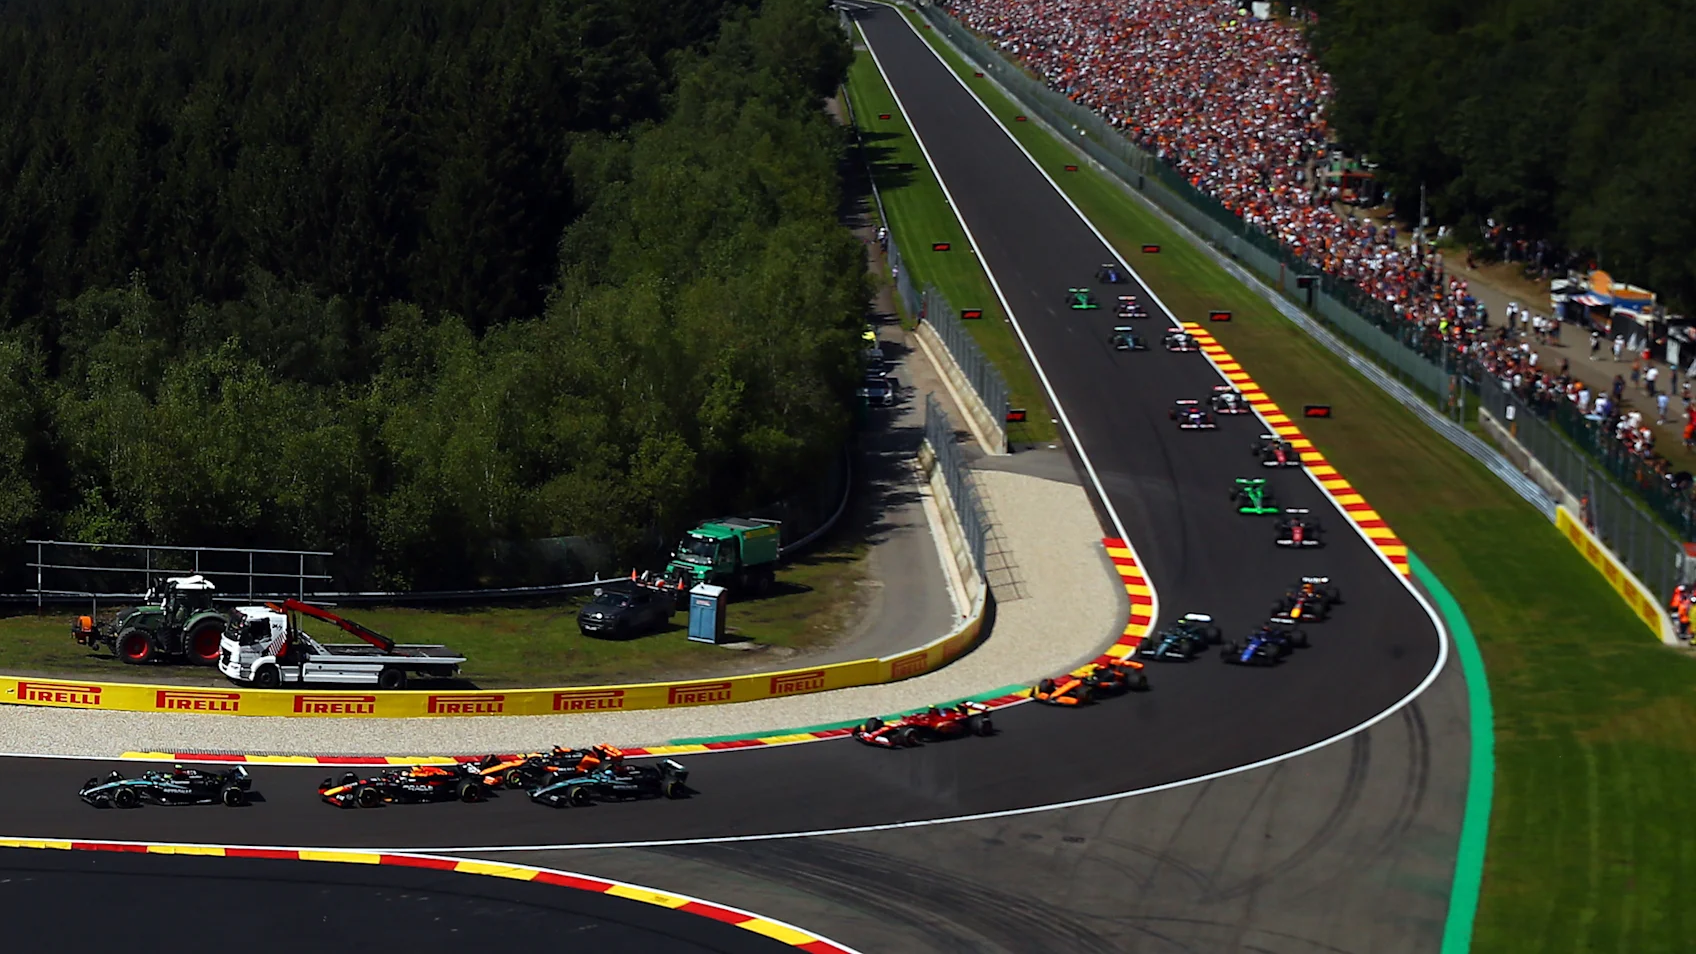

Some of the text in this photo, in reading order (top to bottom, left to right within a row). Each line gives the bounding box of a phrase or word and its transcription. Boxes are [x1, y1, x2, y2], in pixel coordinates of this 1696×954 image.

[18, 682, 101, 705] PIRELLI
[668, 682, 731, 705] PIRELLI
[770, 671, 824, 695] PIRELLI
[156, 691, 240, 712] PIRELLI
[294, 695, 374, 714] PIRELLI
[428, 695, 504, 713] PIRELLI
[553, 690, 624, 711] PIRELLI
